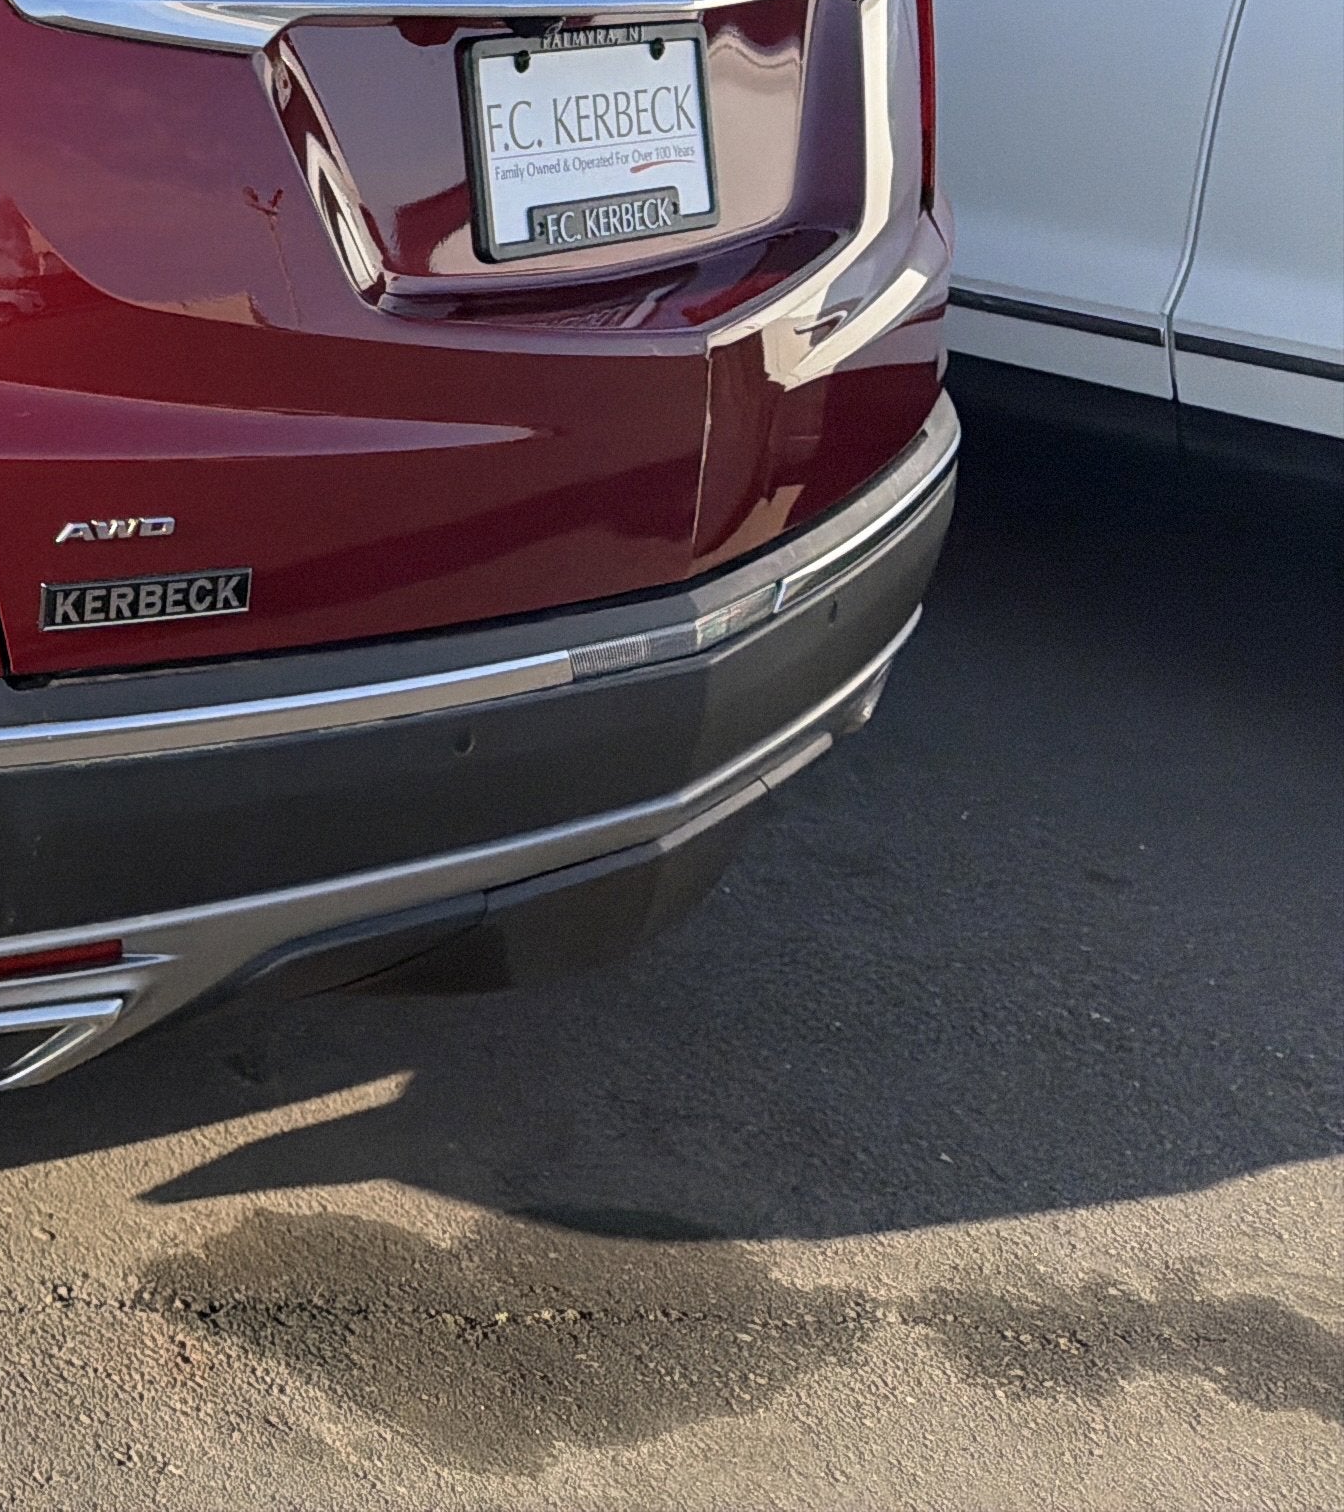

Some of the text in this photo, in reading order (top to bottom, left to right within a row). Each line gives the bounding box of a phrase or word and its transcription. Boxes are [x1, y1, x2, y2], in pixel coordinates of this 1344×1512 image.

[486, 84, 697, 152] F.C. KERBECK
[495, 144, 696, 182] Family Owned & Operated For Over 100 Years
[546, 197, 672, 245] F.C. KERBECK
[54, 516, 176, 544] AWD
[54, 575, 241, 624] KERBECK
